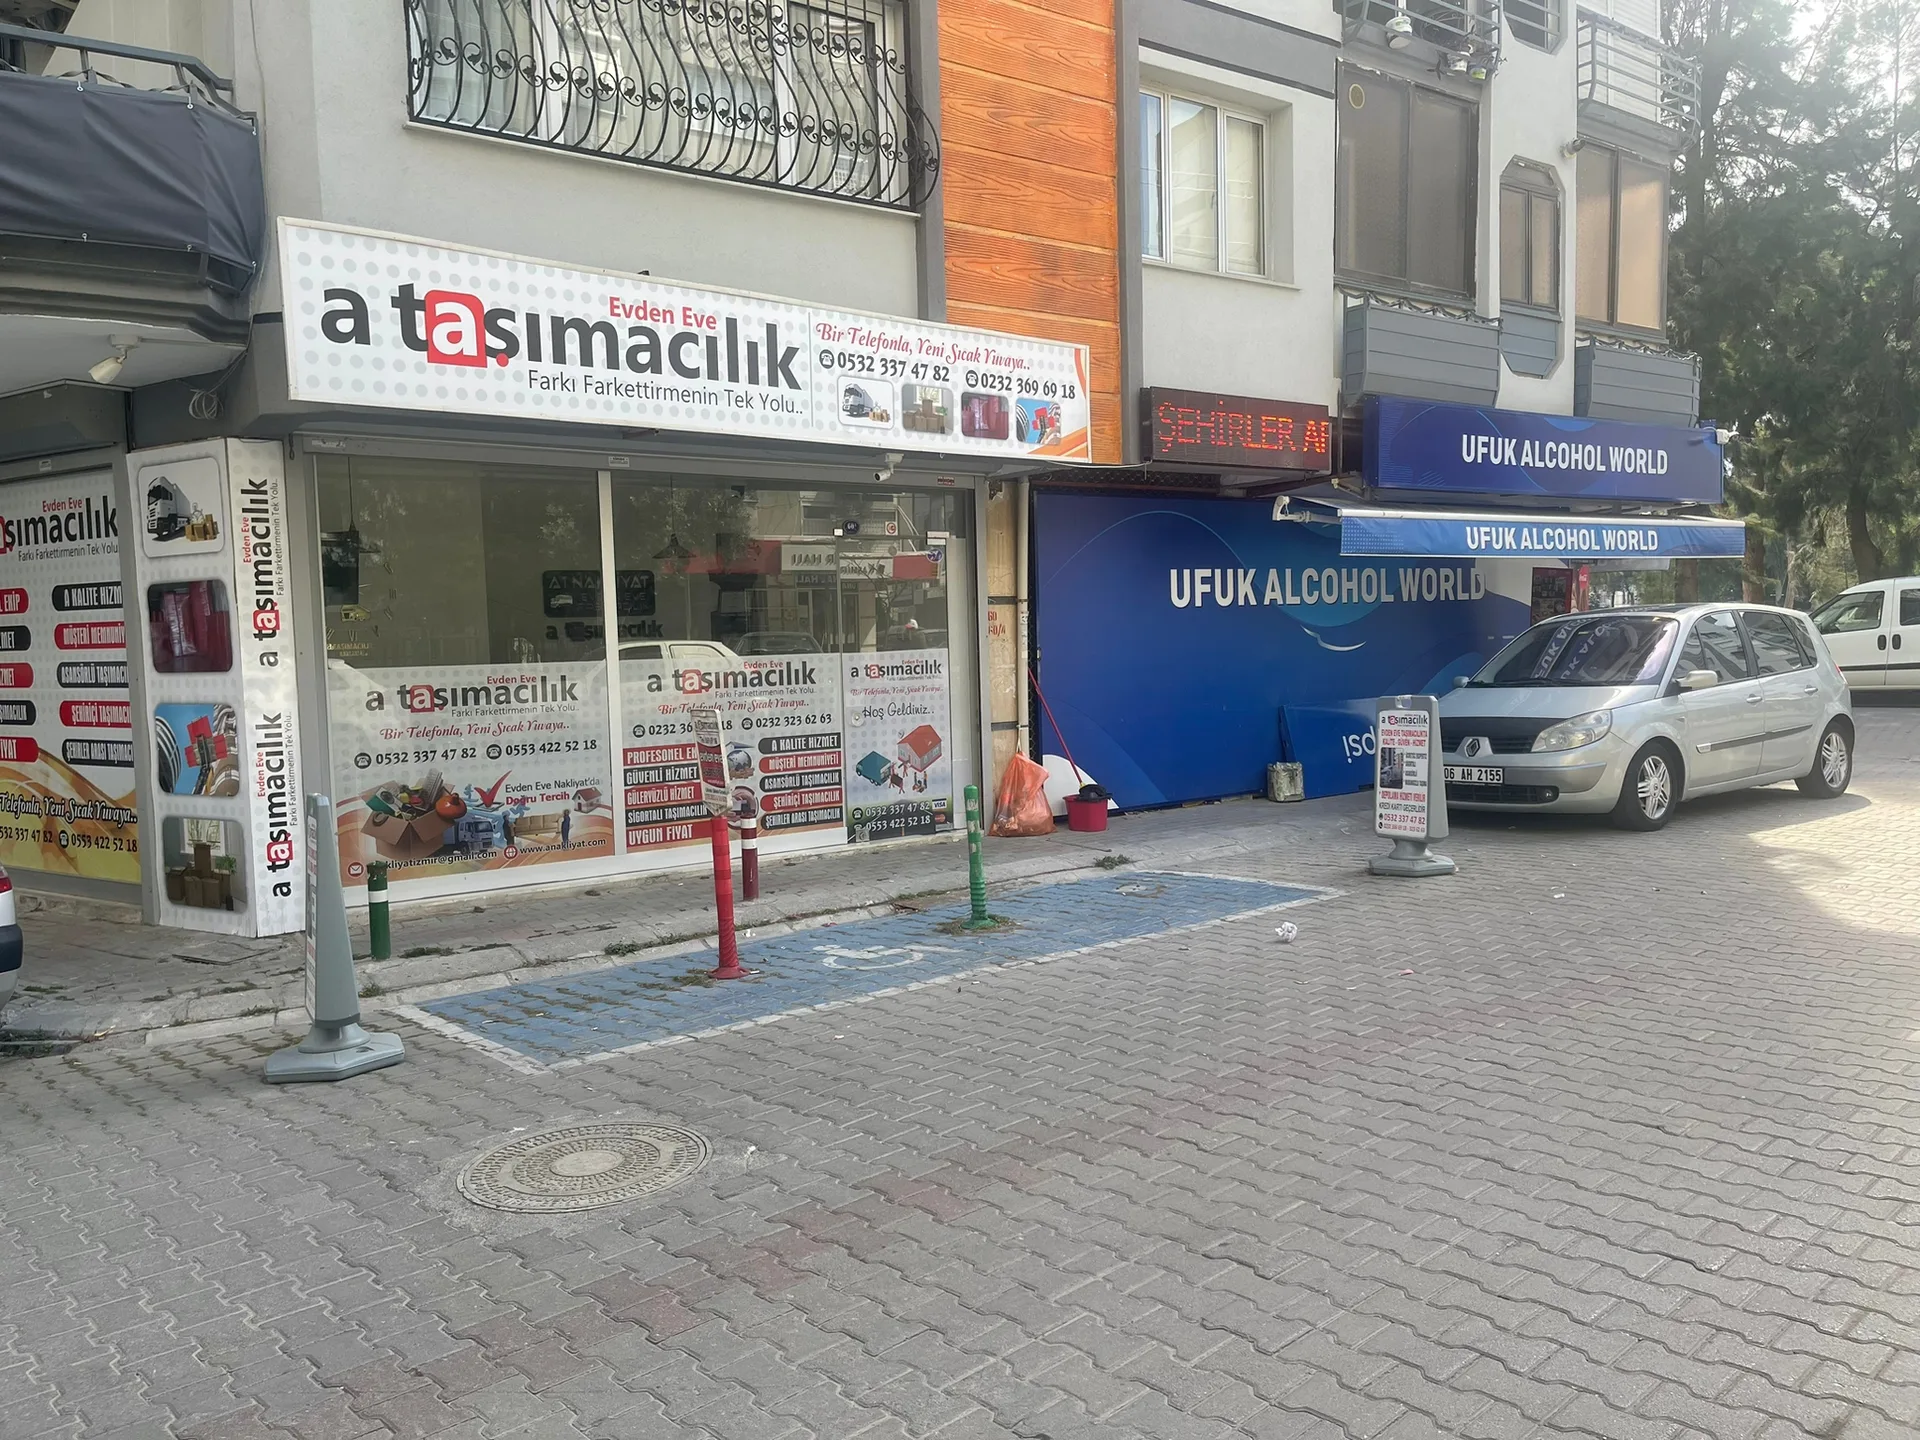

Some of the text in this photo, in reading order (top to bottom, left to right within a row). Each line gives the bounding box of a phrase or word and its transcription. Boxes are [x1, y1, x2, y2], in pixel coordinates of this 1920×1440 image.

[609, 296, 717, 331] Evden Eve
[320, 282, 803, 390] a taşımacılık
[816, 322, 844, 342] Bir
[847, 326, 913, 356] Telefonla,
[917, 337, 945, 358] Yeni
[945, 343, 981, 365] Sıcak
[837, 351, 950, 382] 0532 337 47 82
[528, 369, 803, 415] Farkı Farkettirmenin Tek Yolu..
[981, 372, 1076, 399] 0232 369 69 18
[1462, 434, 1669, 475] UFUK ALCOHOL WORLD
[42, 497, 83, 512] Evden Eve
[271, 502, 280, 518] Tek
[241, 516, 252, 564] Evden Eve
[1465, 526, 1659, 551] UFUK ALCOHOL WORLD
[35, 546, 86, 560] Farkettirmenin
[87, 543, 100, 555] Tek
[1170, 567, 1486, 608] UFUK ALCOHOL WORLD
[259, 651, 279, 668] a
[744, 661, 767, 669] Evden
[487, 674, 537, 685] Evden Eve
[851, 667, 859, 678] a
[647, 674, 662, 692] a
[365, 690, 385, 711] a
[734, 687, 797, 698] Farkettirmenin Tek
[451, 704, 555, 718] Farkı Farkettirmenin Tek
[657, 704, 677, 715] Bir
[727, 700, 747, 711] Yeni
[862, 705, 884, 720] Hoş
[756, 713, 832, 728] 0232 323 62 63
[380, 727, 403, 740] Bir
[406, 724, 463, 741] Telefonla,
[466, 723, 491, 736] Yeni
[492, 720, 524, 737] Sıcak
[649, 724, 676, 736] 0232
[286, 733, 294, 749] Tek
[506, 739, 597, 757] 0553 422 52 18
[772, 740, 777, 751] A
[809, 735, 837, 748] HİZMET
[375, 747, 477, 765] 0532 337 47 82
[627, 748, 684, 764] PROFESONEL
[769, 755, 796, 771] MÜŞTERİ
[255, 751, 266, 798] Evden Eve
[626, 767, 662, 785] GÜVENLİ
[665, 766, 697, 780] HİZMET
[1444, 767, 1502, 781] 06 AH 2155
[505, 782, 533, 794] Evden
[535, 780, 552, 792] Eve
[670, 786, 694, 801] HİZMET
[44, 796, 65, 817] Yeni
[505, 791, 570, 807] Doğru Tercih
[628, 808, 663, 823] SİGORTALI
[865, 801, 930, 817] 0532 337 47 82
[865, 815, 931, 832] 0553 422 52 18
[1384, 814, 1426, 825] 0532 337 47 82
[15, 827, 53, 844] 337 47 82
[71, 833, 138, 853] 0553 422 52 18
[629, 824, 693, 845] UYGUN FİYAT
[519, 837, 606, 855] www.anakliyat.com
[272, 881, 292, 898] a
